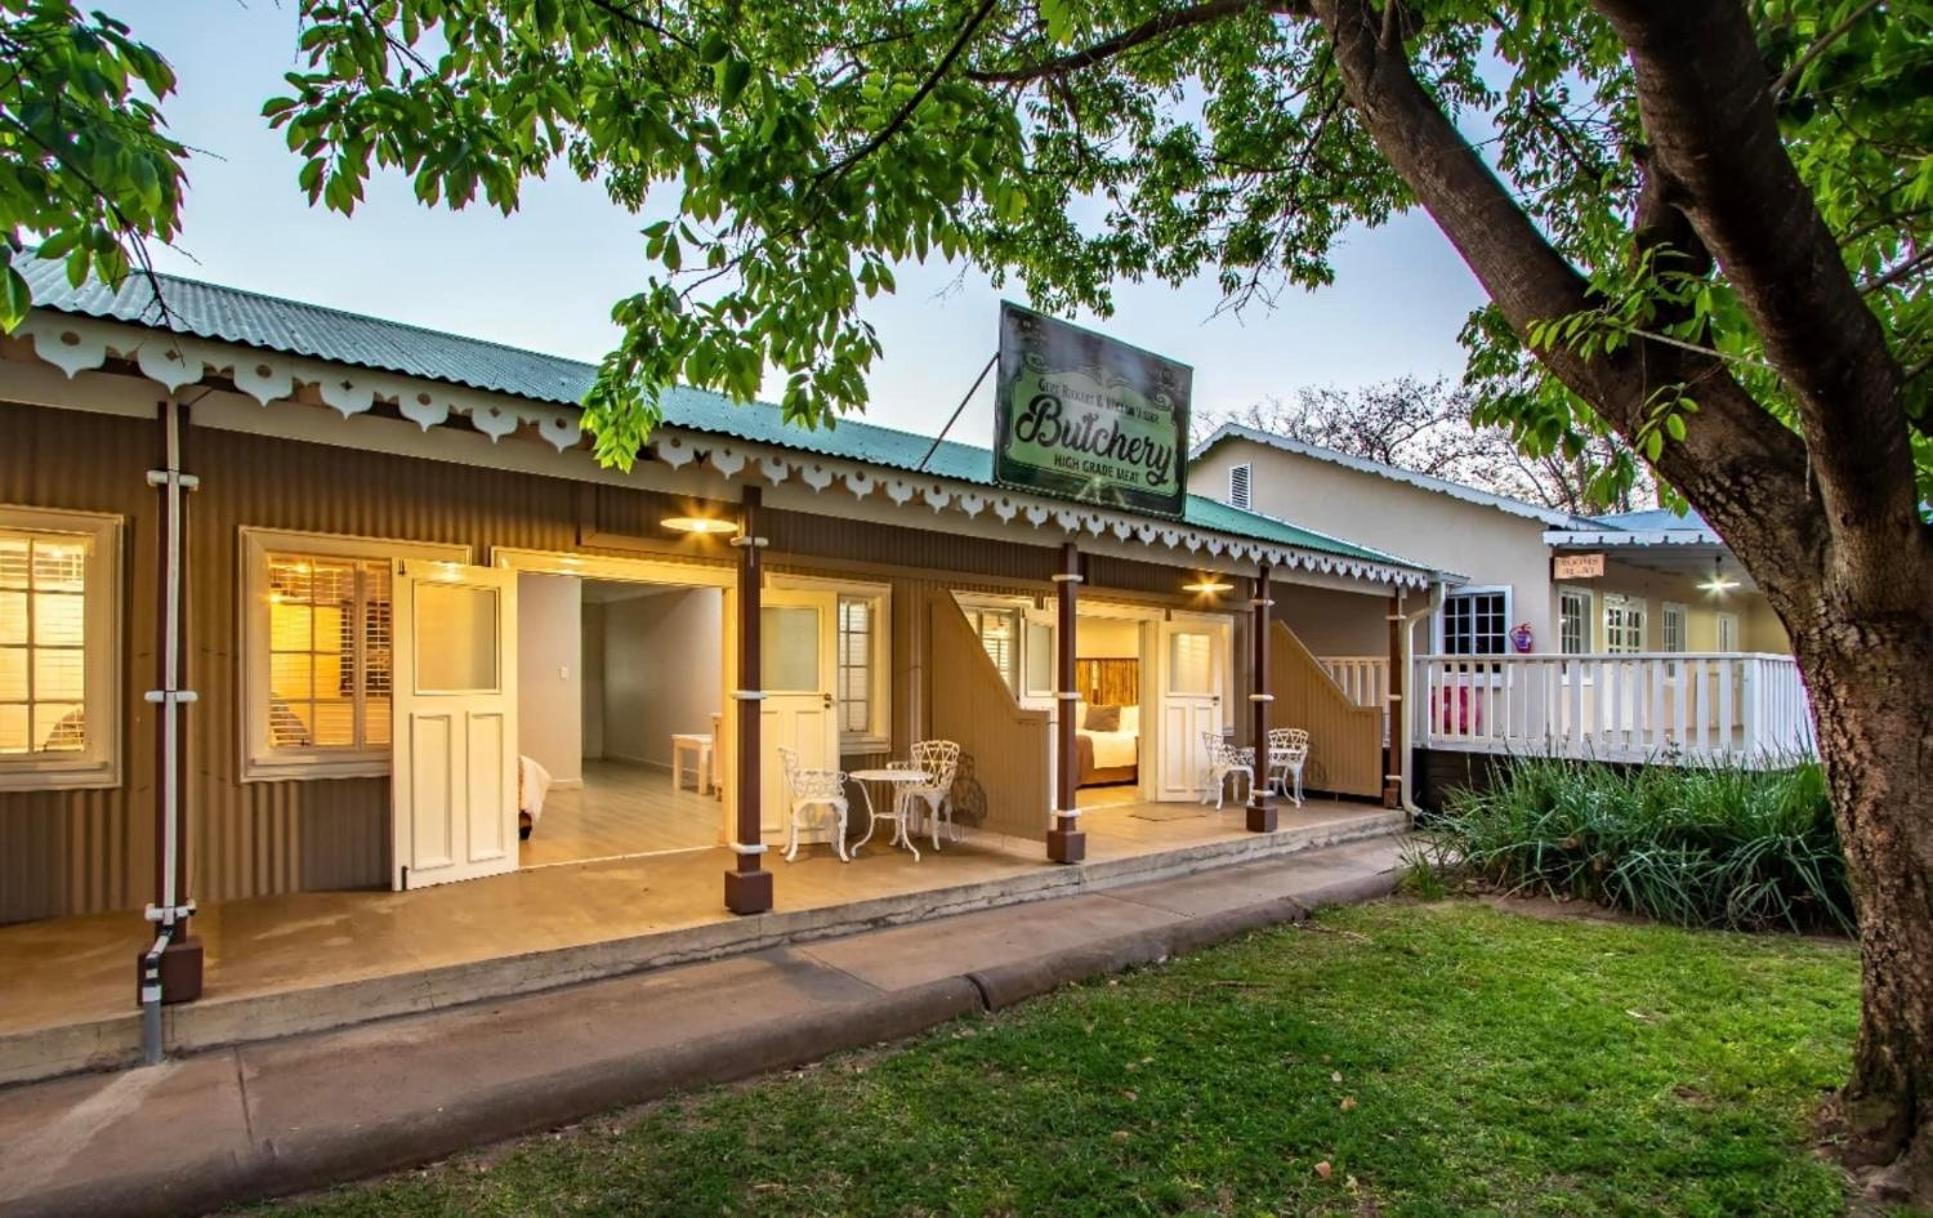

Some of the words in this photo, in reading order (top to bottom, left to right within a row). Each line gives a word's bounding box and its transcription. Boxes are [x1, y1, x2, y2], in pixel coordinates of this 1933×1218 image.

[1015, 394, 1171, 486] Butchery
[1054, 454, 1080, 472] HIGH
[1082, 461, 1114, 477] GRADE
[1116, 467, 1140, 483] MEAT
